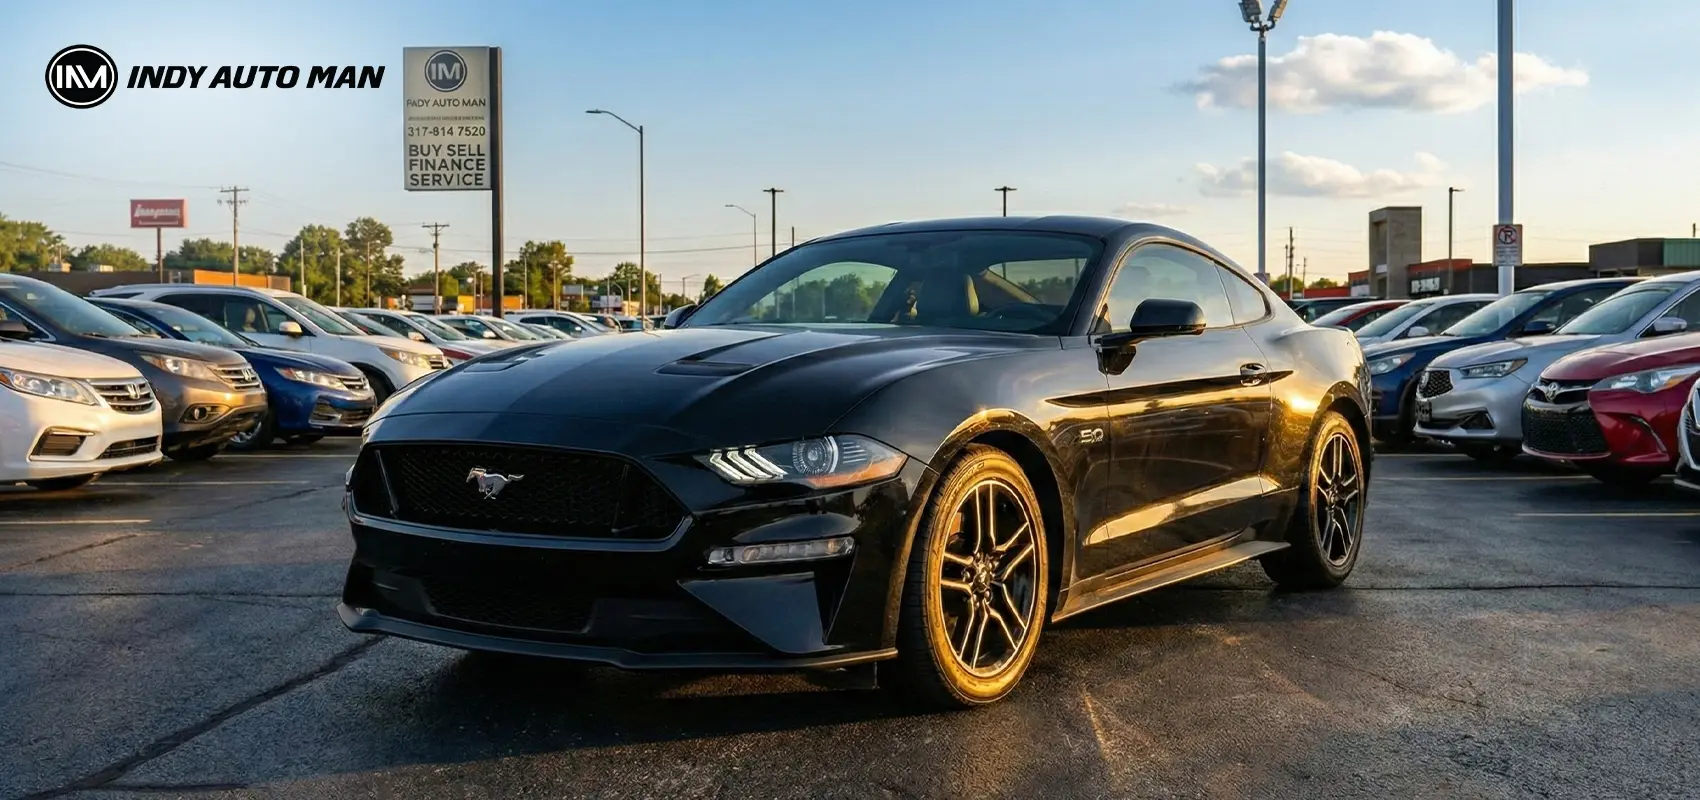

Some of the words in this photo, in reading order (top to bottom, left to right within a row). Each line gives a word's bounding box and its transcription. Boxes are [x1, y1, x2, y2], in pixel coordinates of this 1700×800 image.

[432, 98, 460, 108] AUTO
[462, 98, 486, 108] MAN
[408, 126, 454, 137] 317-814
[458, 126, 486, 137] 7520
[408, 144, 442, 157] BUY
[447, 144, 486, 157] SELL
[409, 158, 486, 171] FINANCE
[410, 173, 484, 187] SERVICE
